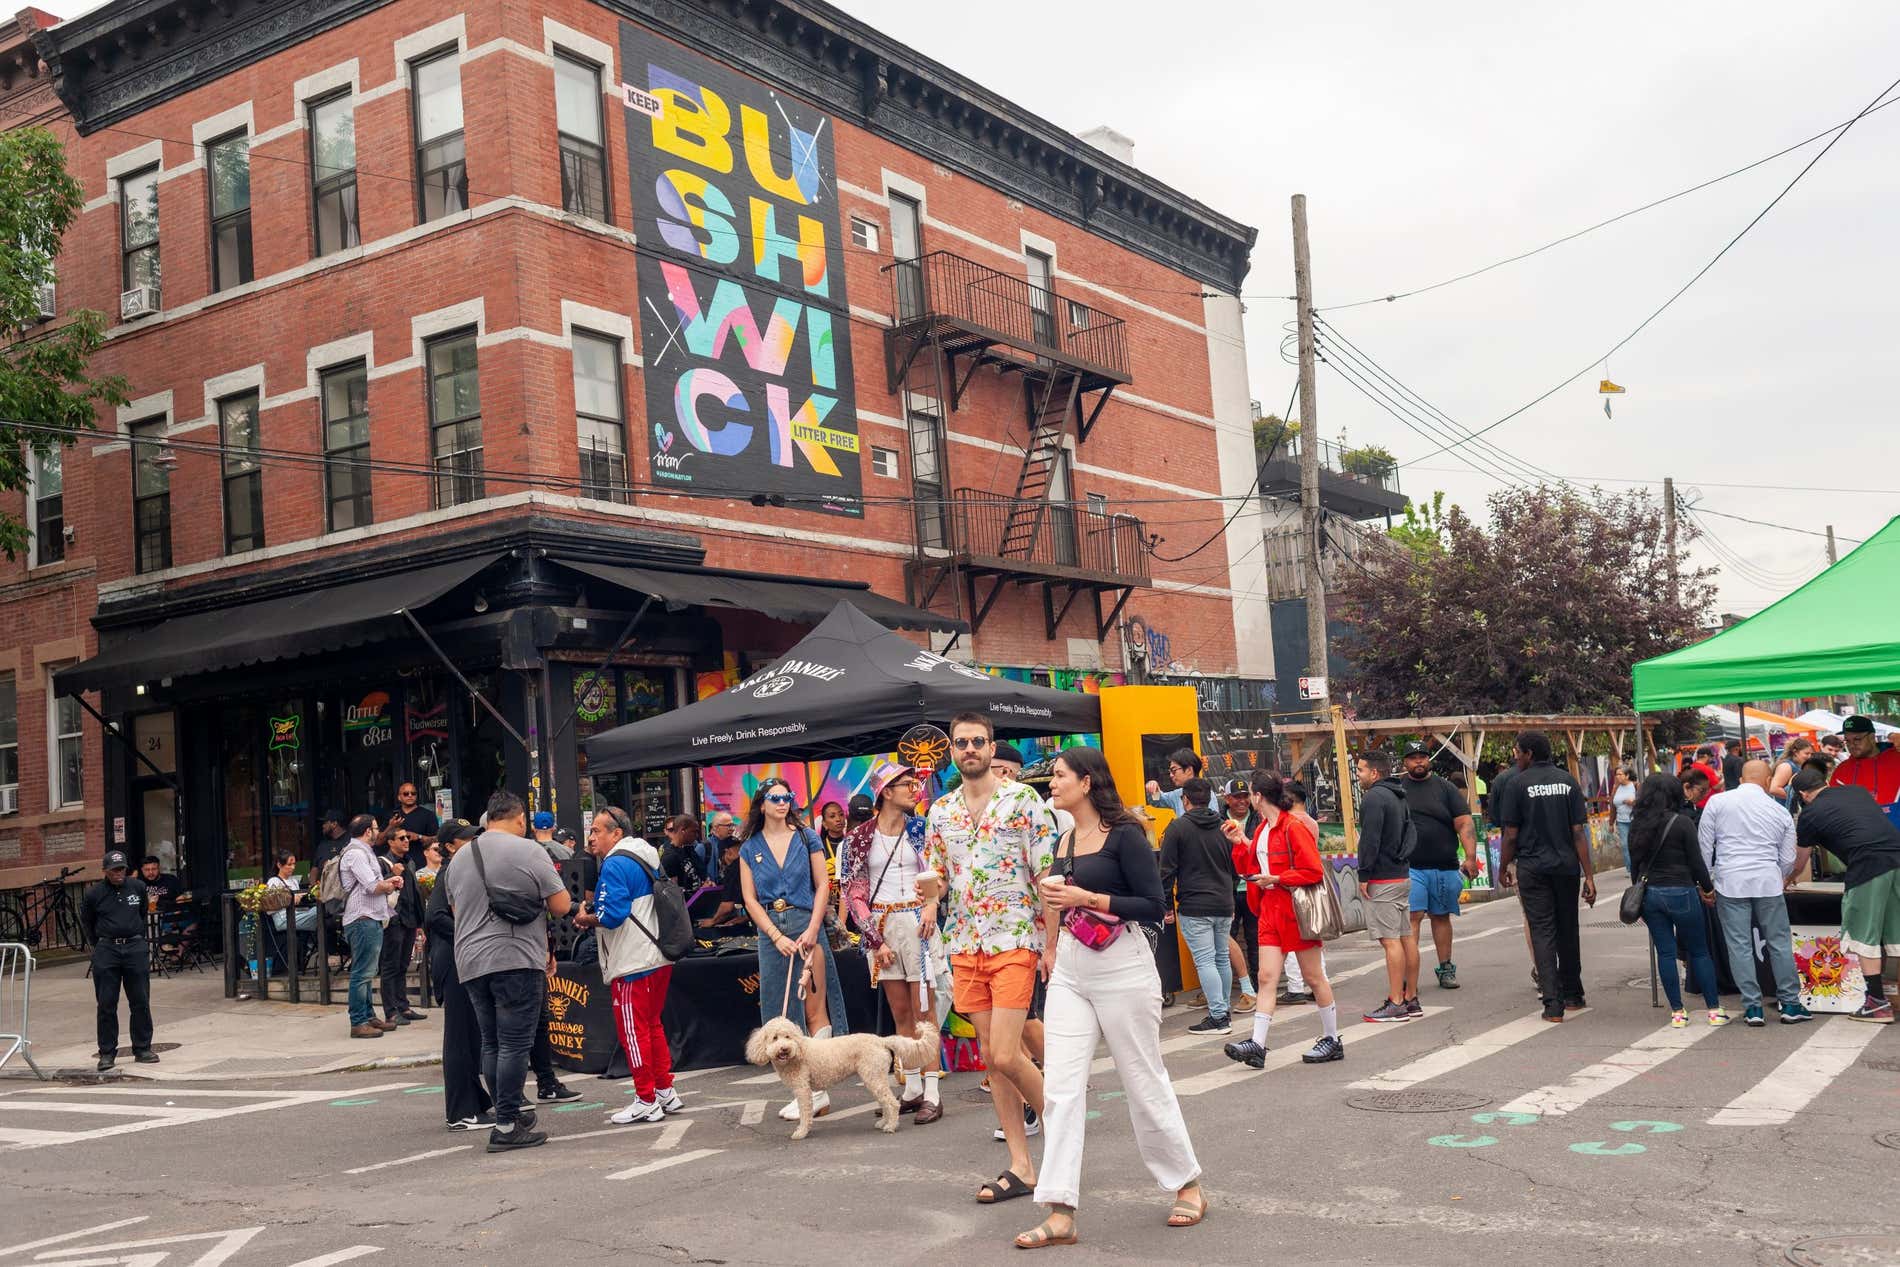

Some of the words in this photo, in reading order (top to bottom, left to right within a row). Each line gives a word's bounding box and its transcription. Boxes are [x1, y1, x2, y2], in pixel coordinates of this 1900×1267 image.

[627, 89, 659, 112] KEEP
[648, 63, 820, 205] BU
[656, 169, 830, 298] SH
[659, 260, 837, 390] WI
[674, 367, 842, 477] CK
[793, 424, 827, 443] LITTER
[830, 433, 855, 449] FREE
[410, 718, 448, 731] Budweiser
[692, 736, 708, 746] Live
[709, 732, 734, 743] Freely.
[736, 729, 757, 740] Drink
[758, 722, 808, 737] Responsibly.
[363, 726, 392, 747] BEA
[1237, 781, 1245, 789] P
[1527, 783, 1571, 798] SECURITY
[548, 1021, 585, 1034] nnessee
[549, 1033, 587, 1049] ONEY
